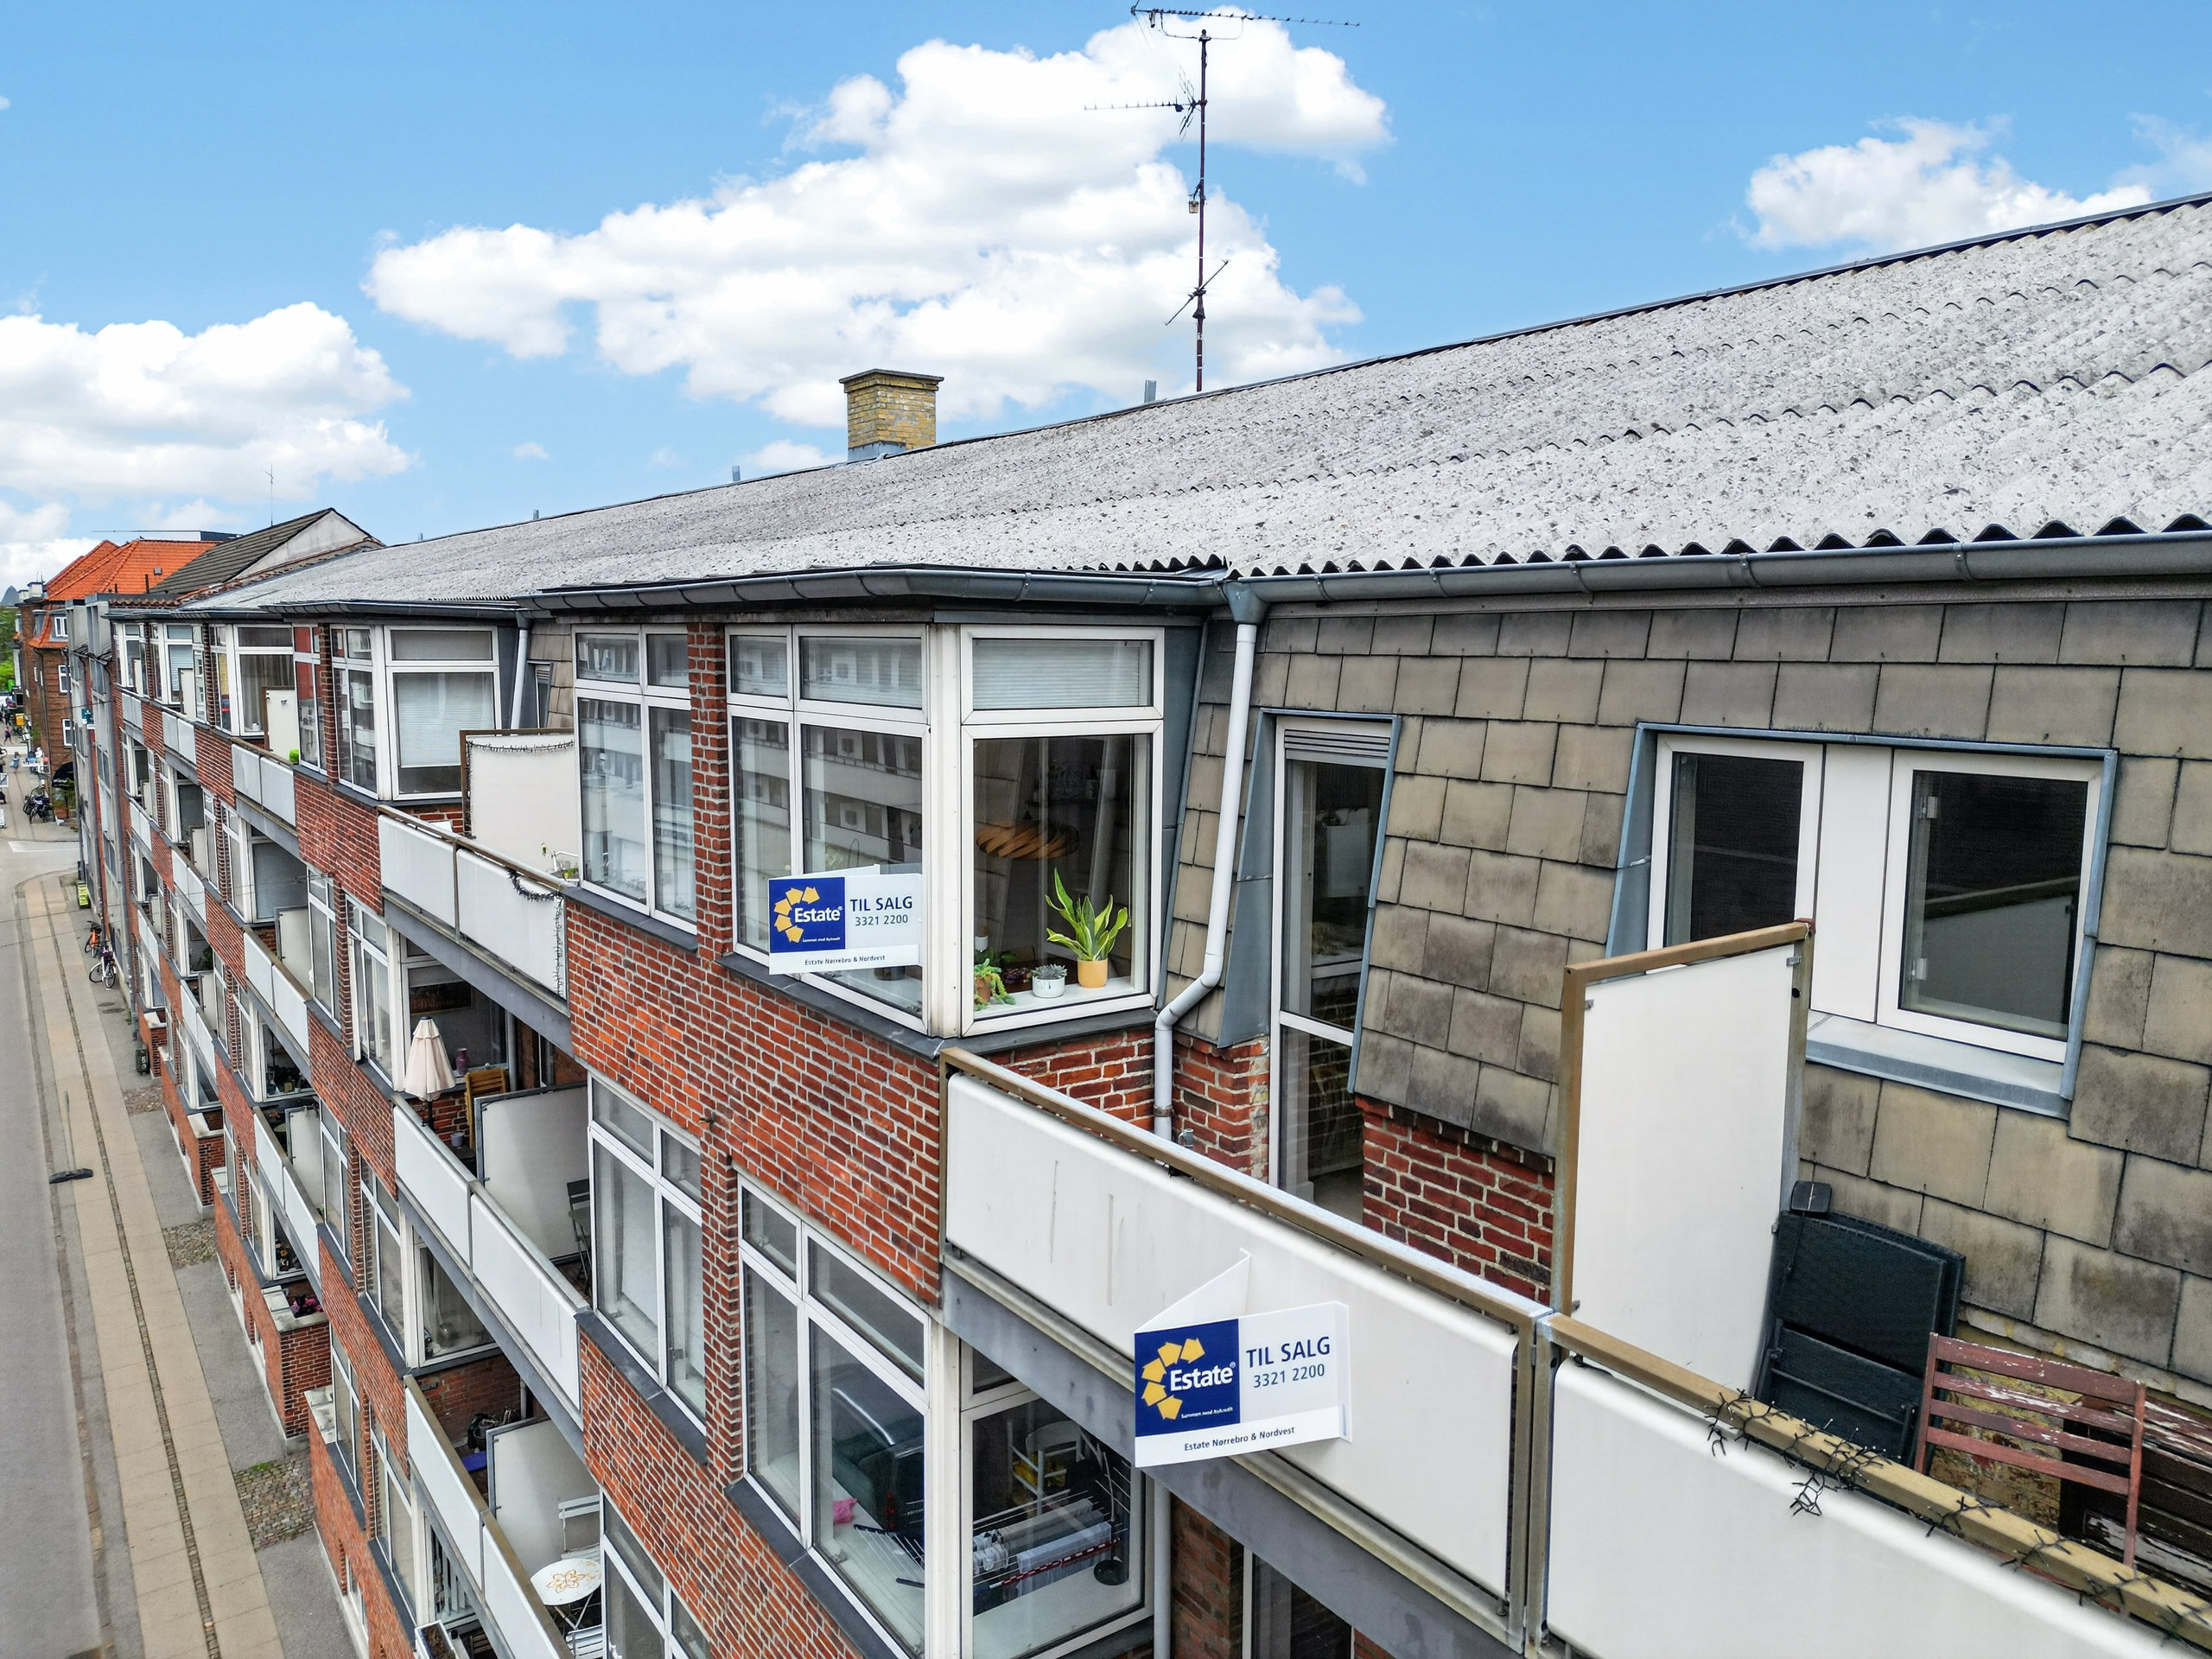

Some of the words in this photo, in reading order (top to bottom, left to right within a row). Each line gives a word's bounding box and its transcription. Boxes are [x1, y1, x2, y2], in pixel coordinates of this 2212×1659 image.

[850, 899, 871, 912] TIL
[875, 896, 912, 911] SALG
[855, 916, 880, 926] 3321
[884, 914, 908, 925] 2200
[1246, 1346, 1274, 1368] TIL
[1281, 1336, 1331, 1363] SALG
[1253, 1370, 1286, 1389] 3321
[1292, 1363, 1325, 1382] 2200
[1184, 1440, 1210, 1452] Estate
[1212, 1434, 1249, 1447] Nørrebro
[1259, 1427, 1295, 1440] Nordvest
